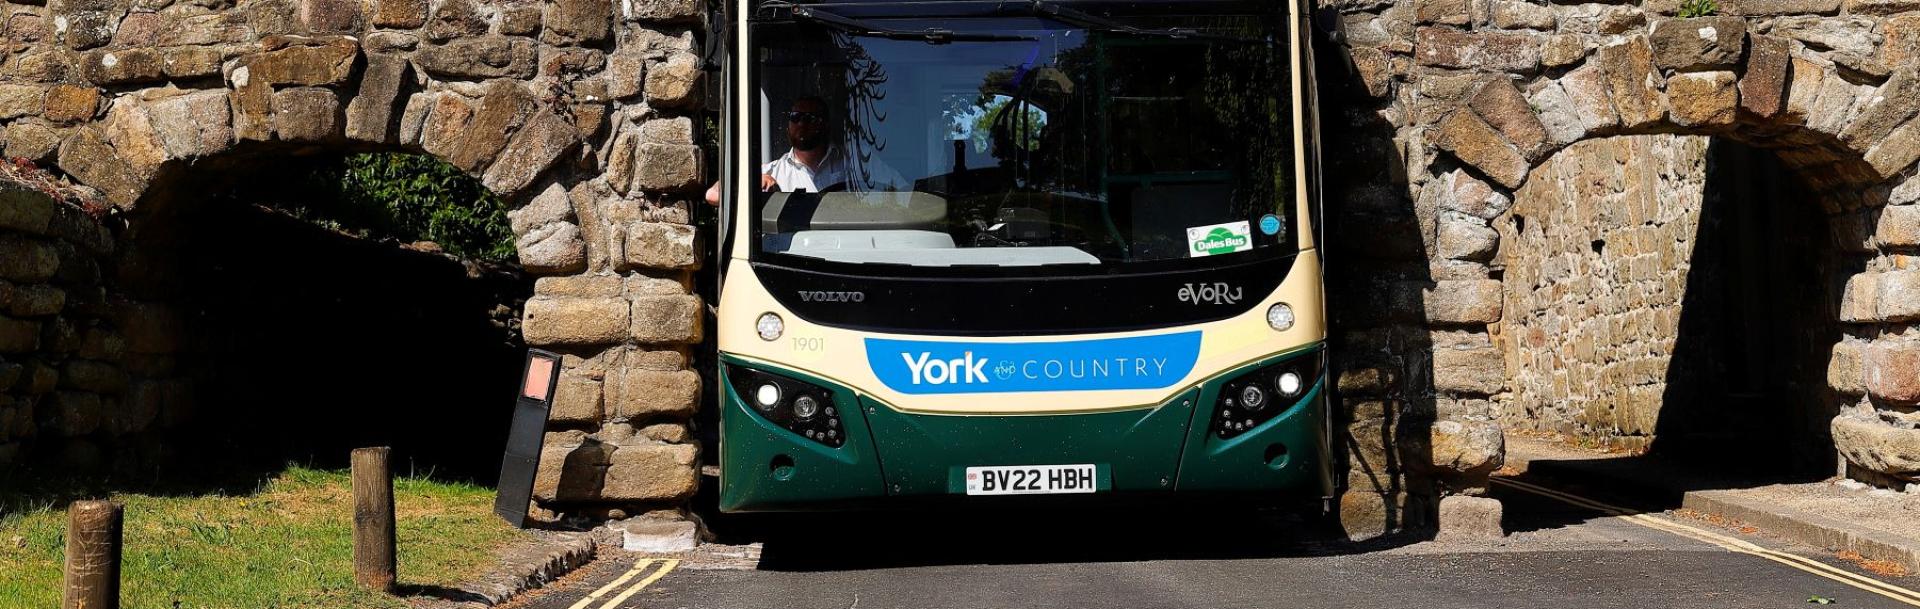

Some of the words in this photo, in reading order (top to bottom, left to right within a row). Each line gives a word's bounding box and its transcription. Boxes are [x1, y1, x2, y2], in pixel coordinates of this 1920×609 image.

[1198, 240, 1225, 250] Dales
[1225, 237, 1244, 247] Bus
[798, 290, 865, 302] VOLVO
[792, 337, 824, 352] 1901
[901, 351, 989, 385] York
[1022, 357, 1167, 379] COUNTRY
[982, 469, 1041, 491] BV22
[1048, 468, 1093, 490] HBH
